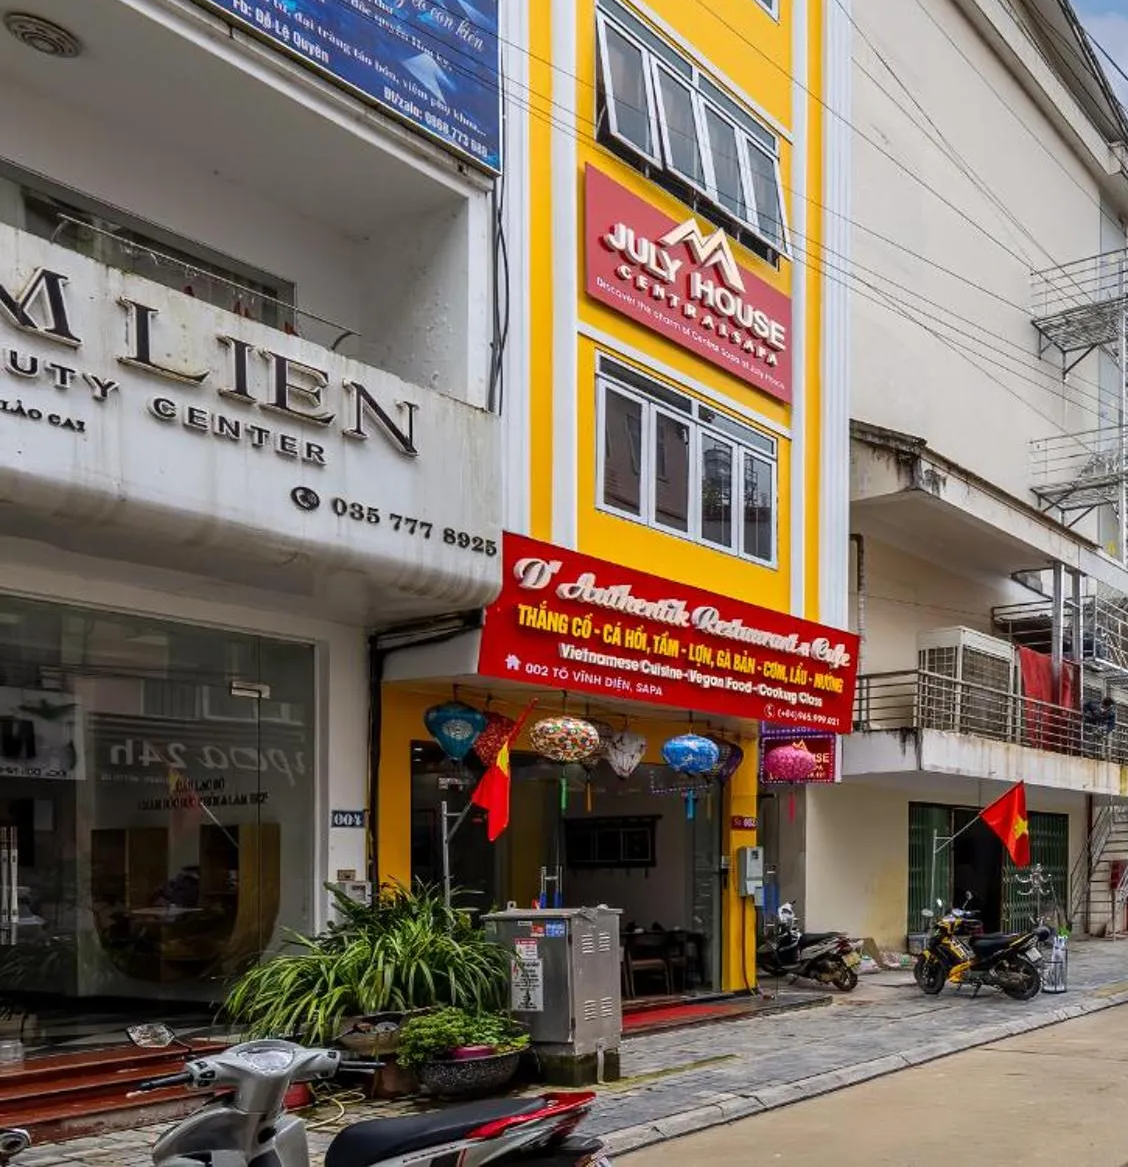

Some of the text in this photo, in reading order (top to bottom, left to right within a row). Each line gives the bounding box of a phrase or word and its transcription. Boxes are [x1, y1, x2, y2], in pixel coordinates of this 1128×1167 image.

[603, 222, 786, 353] JULY HOUSE
[5, 348, 120, 402] UTY
[115, 295, 420, 458] LIEN
[48, 413, 86, 433] CAI
[148, 396, 328, 466] CENTER
[331, 497, 498, 557] 035 777 8925
[517, 601, 569, 634] THẮNG
[602, 621, 622, 646] CÁ
[525, 662, 549, 676] 002
[635, 681, 664, 696] SAPA
[559, 642, 639, 671] Vietnamese
